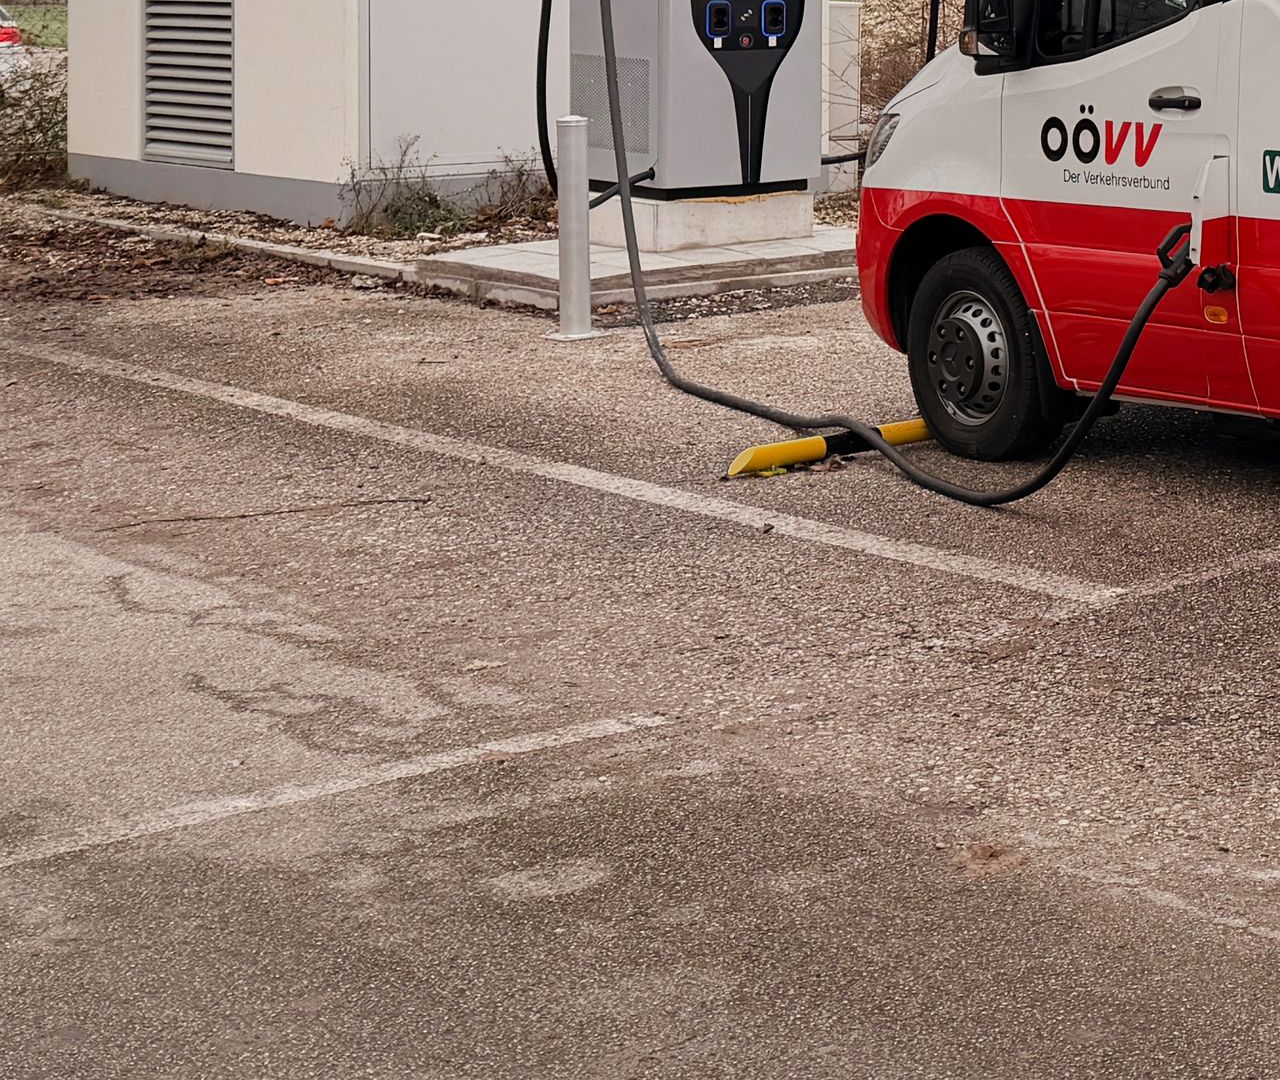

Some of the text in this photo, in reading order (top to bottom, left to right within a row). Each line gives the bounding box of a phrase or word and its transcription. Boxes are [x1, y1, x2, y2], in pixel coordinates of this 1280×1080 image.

[1040, 104, 1163, 168] OÖVV
[1063, 169, 1170, 190] Der Verkehrsverbund
